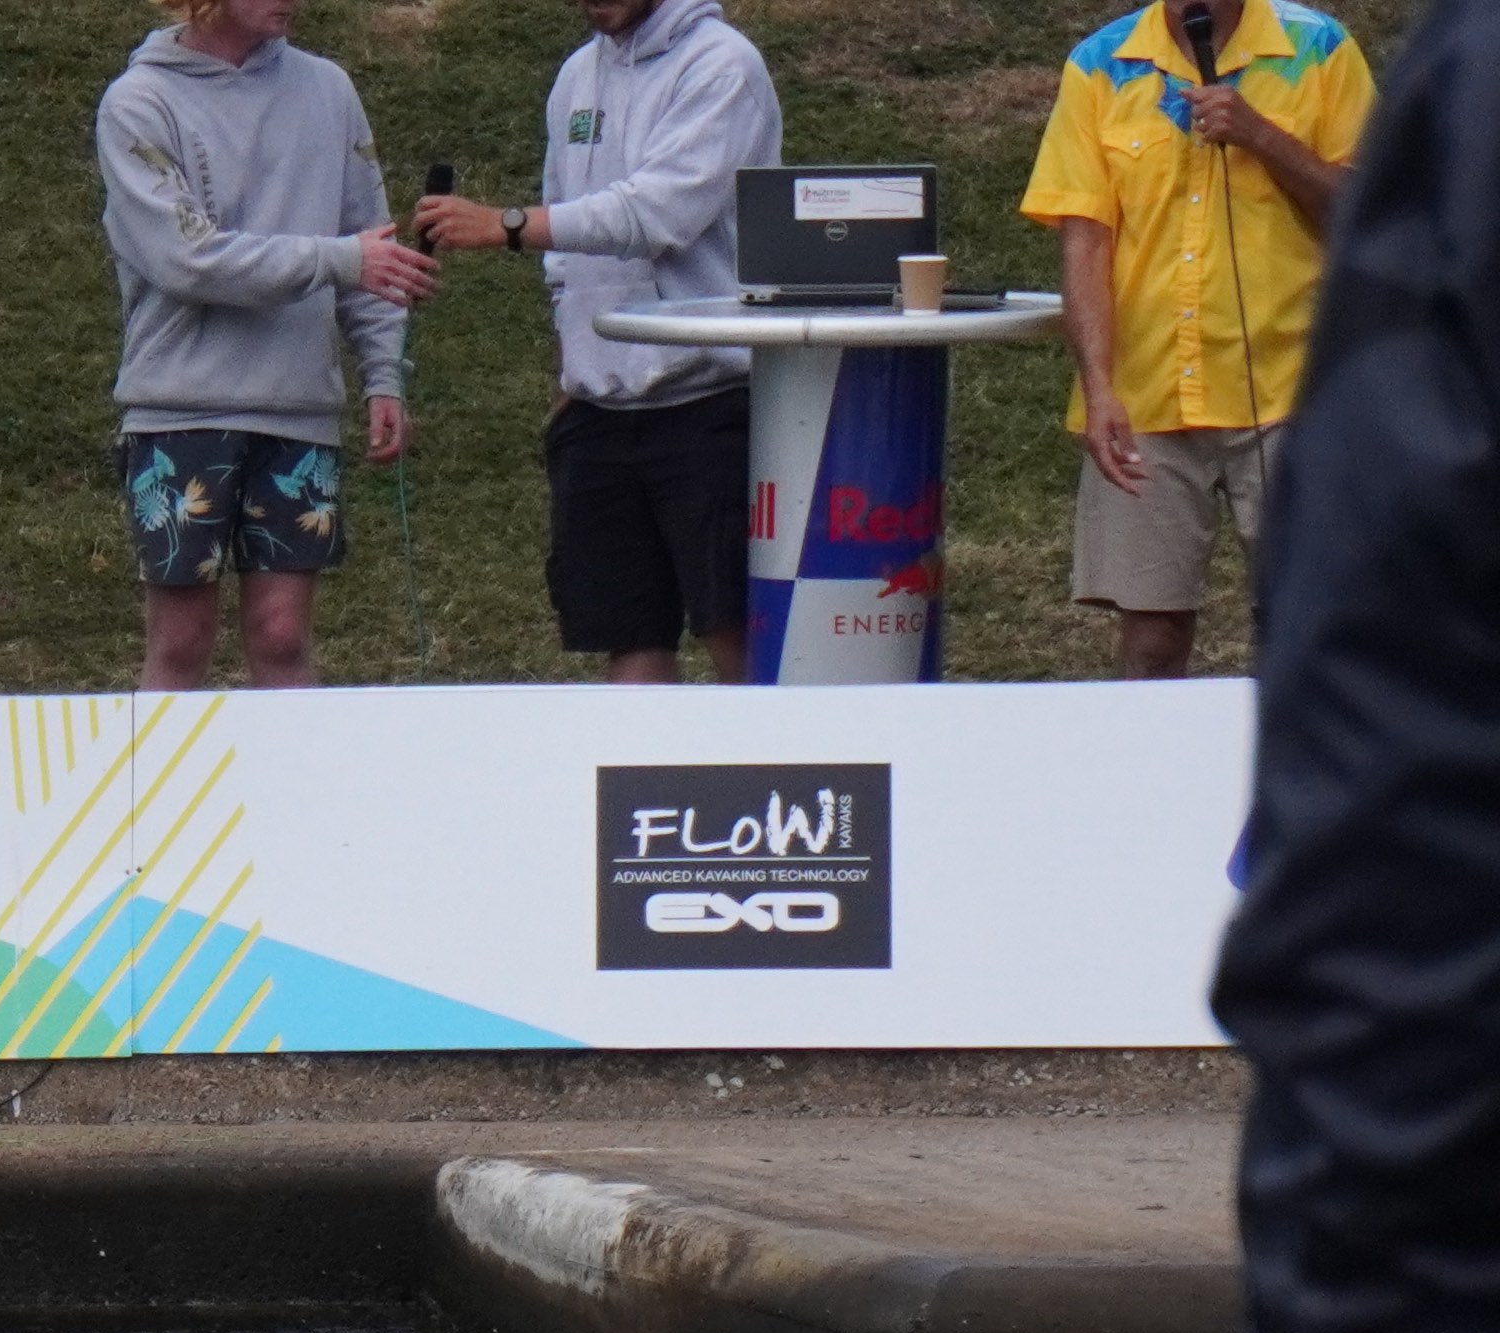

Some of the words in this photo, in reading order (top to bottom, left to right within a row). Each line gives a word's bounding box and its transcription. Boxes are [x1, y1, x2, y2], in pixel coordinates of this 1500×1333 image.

[834, 613, 924, 635] ENERG
[839, 794, 852, 849] KAYAKS
[613, 869, 693, 883] ADVANCED
[696, 869, 767, 882] KAYAKING
[771, 868, 870, 882] TECHNOLOGY
[646, 891, 840, 932] EXO
